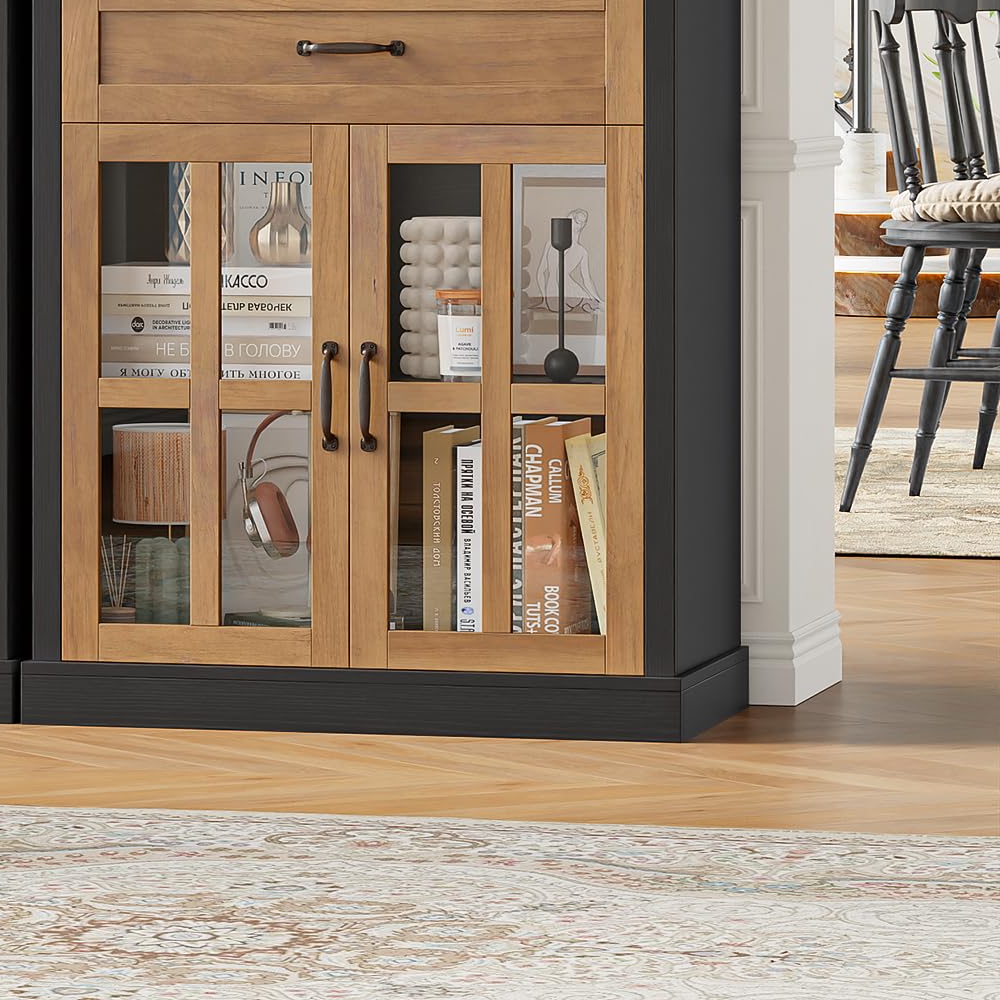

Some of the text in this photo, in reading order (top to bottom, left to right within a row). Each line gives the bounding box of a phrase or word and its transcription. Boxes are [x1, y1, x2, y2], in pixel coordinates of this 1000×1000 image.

[240, 171, 312, 186] INFO
[156, 342, 176, 356] НЕ
[224, 344, 234, 357] В
[239, 343, 302, 358] ГОЛОВУ
[119, 368, 301, 379] Я МОГУ МНОГОЕ
[525, 444, 543, 517] CHAPMAN
[548, 459, 562, 504] CALLUM
[460, 459, 476, 604] ПРЯТКИ НА ОСЕВОЙ ВЛАДИМИР ВАСИЛЬЕВ
[432, 548, 441, 567] ДОМ
[544, 586, 560, 615] BOOK
